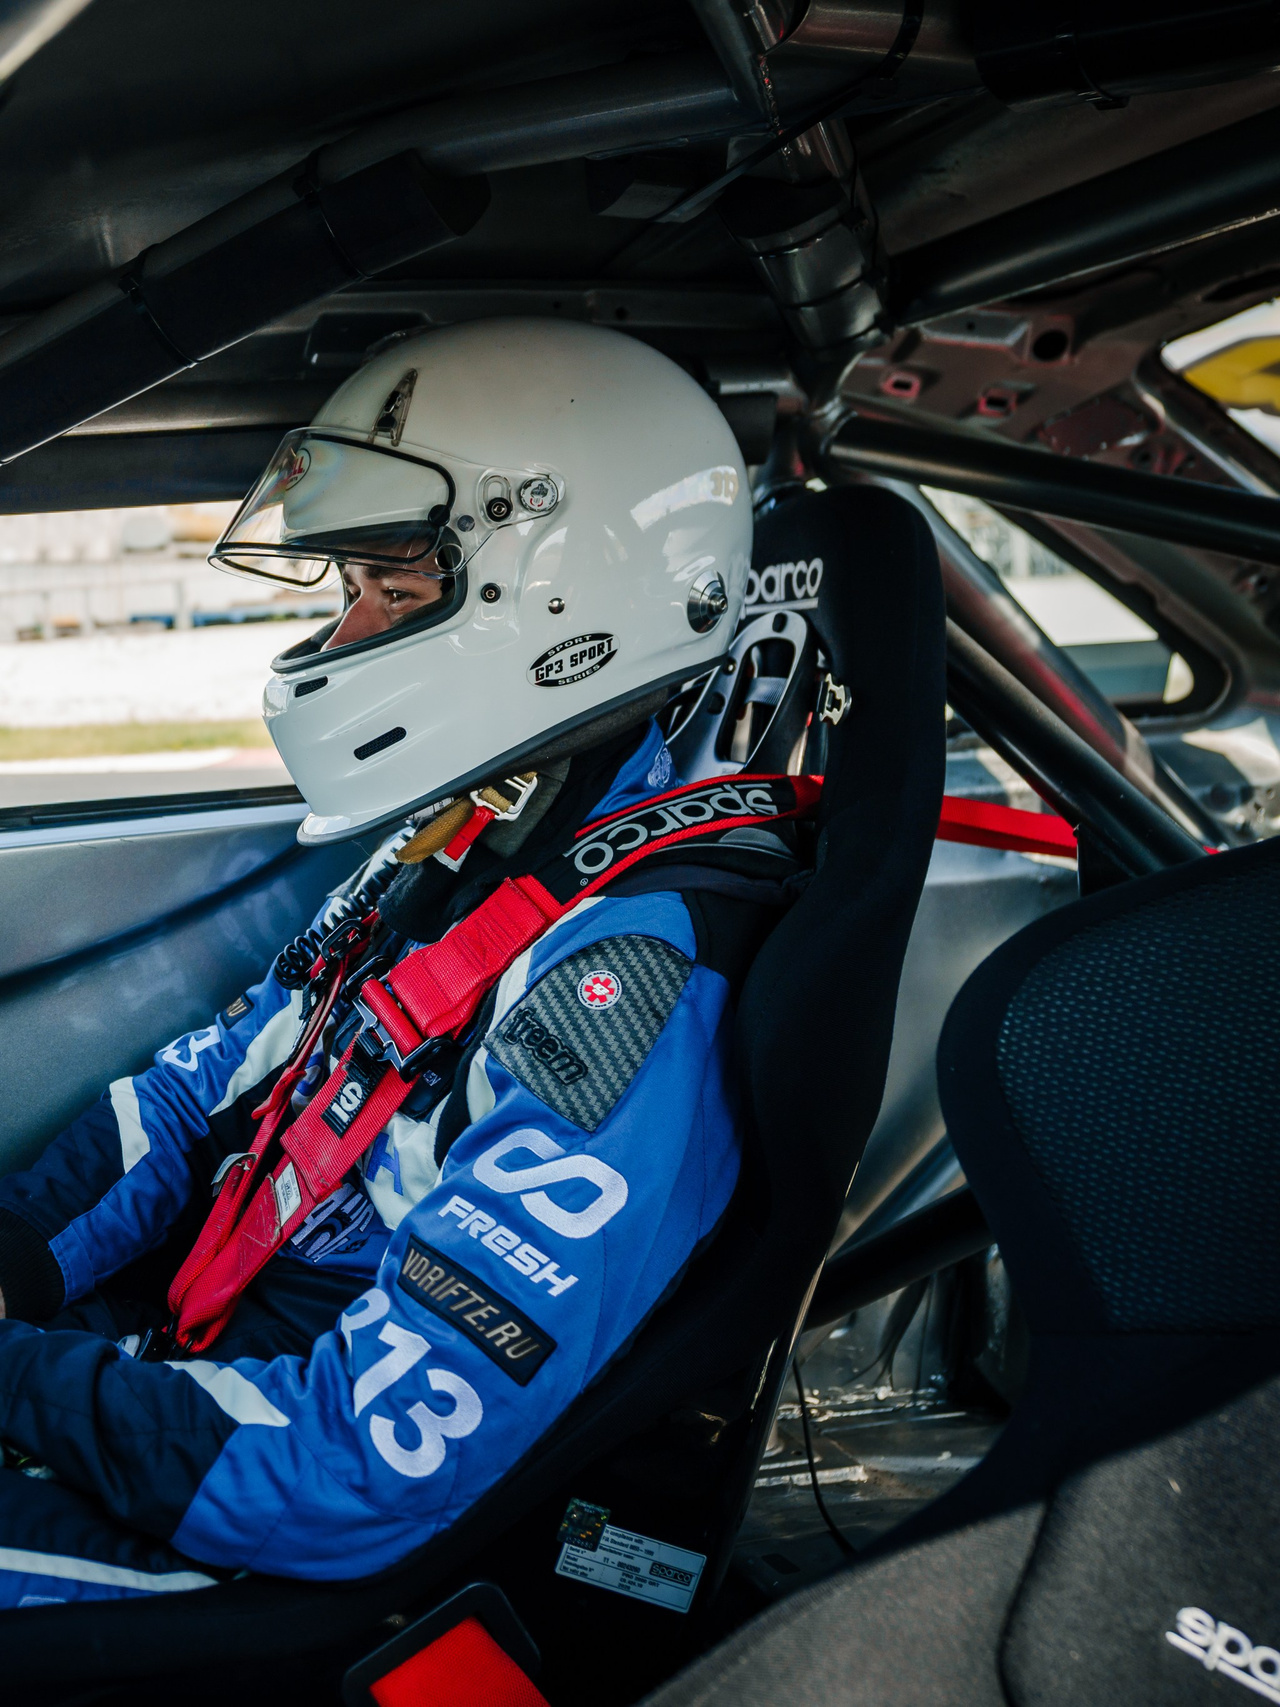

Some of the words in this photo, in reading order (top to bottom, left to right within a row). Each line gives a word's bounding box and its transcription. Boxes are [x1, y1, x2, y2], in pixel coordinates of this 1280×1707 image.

[740, 557, 824, 616] parco
[534, 658, 564, 682] GP3
[569, 637, 614, 668] SPORT
[548, 635, 592, 657] SPORT
[557, 664, 600, 686] SERIES
[573, 784, 779, 875] sparco
[504, 1008, 587, 1084] freem
[401, 1247, 542, 1361] VDRIFTE.RU
[651, 1564, 692, 1586] sparco
